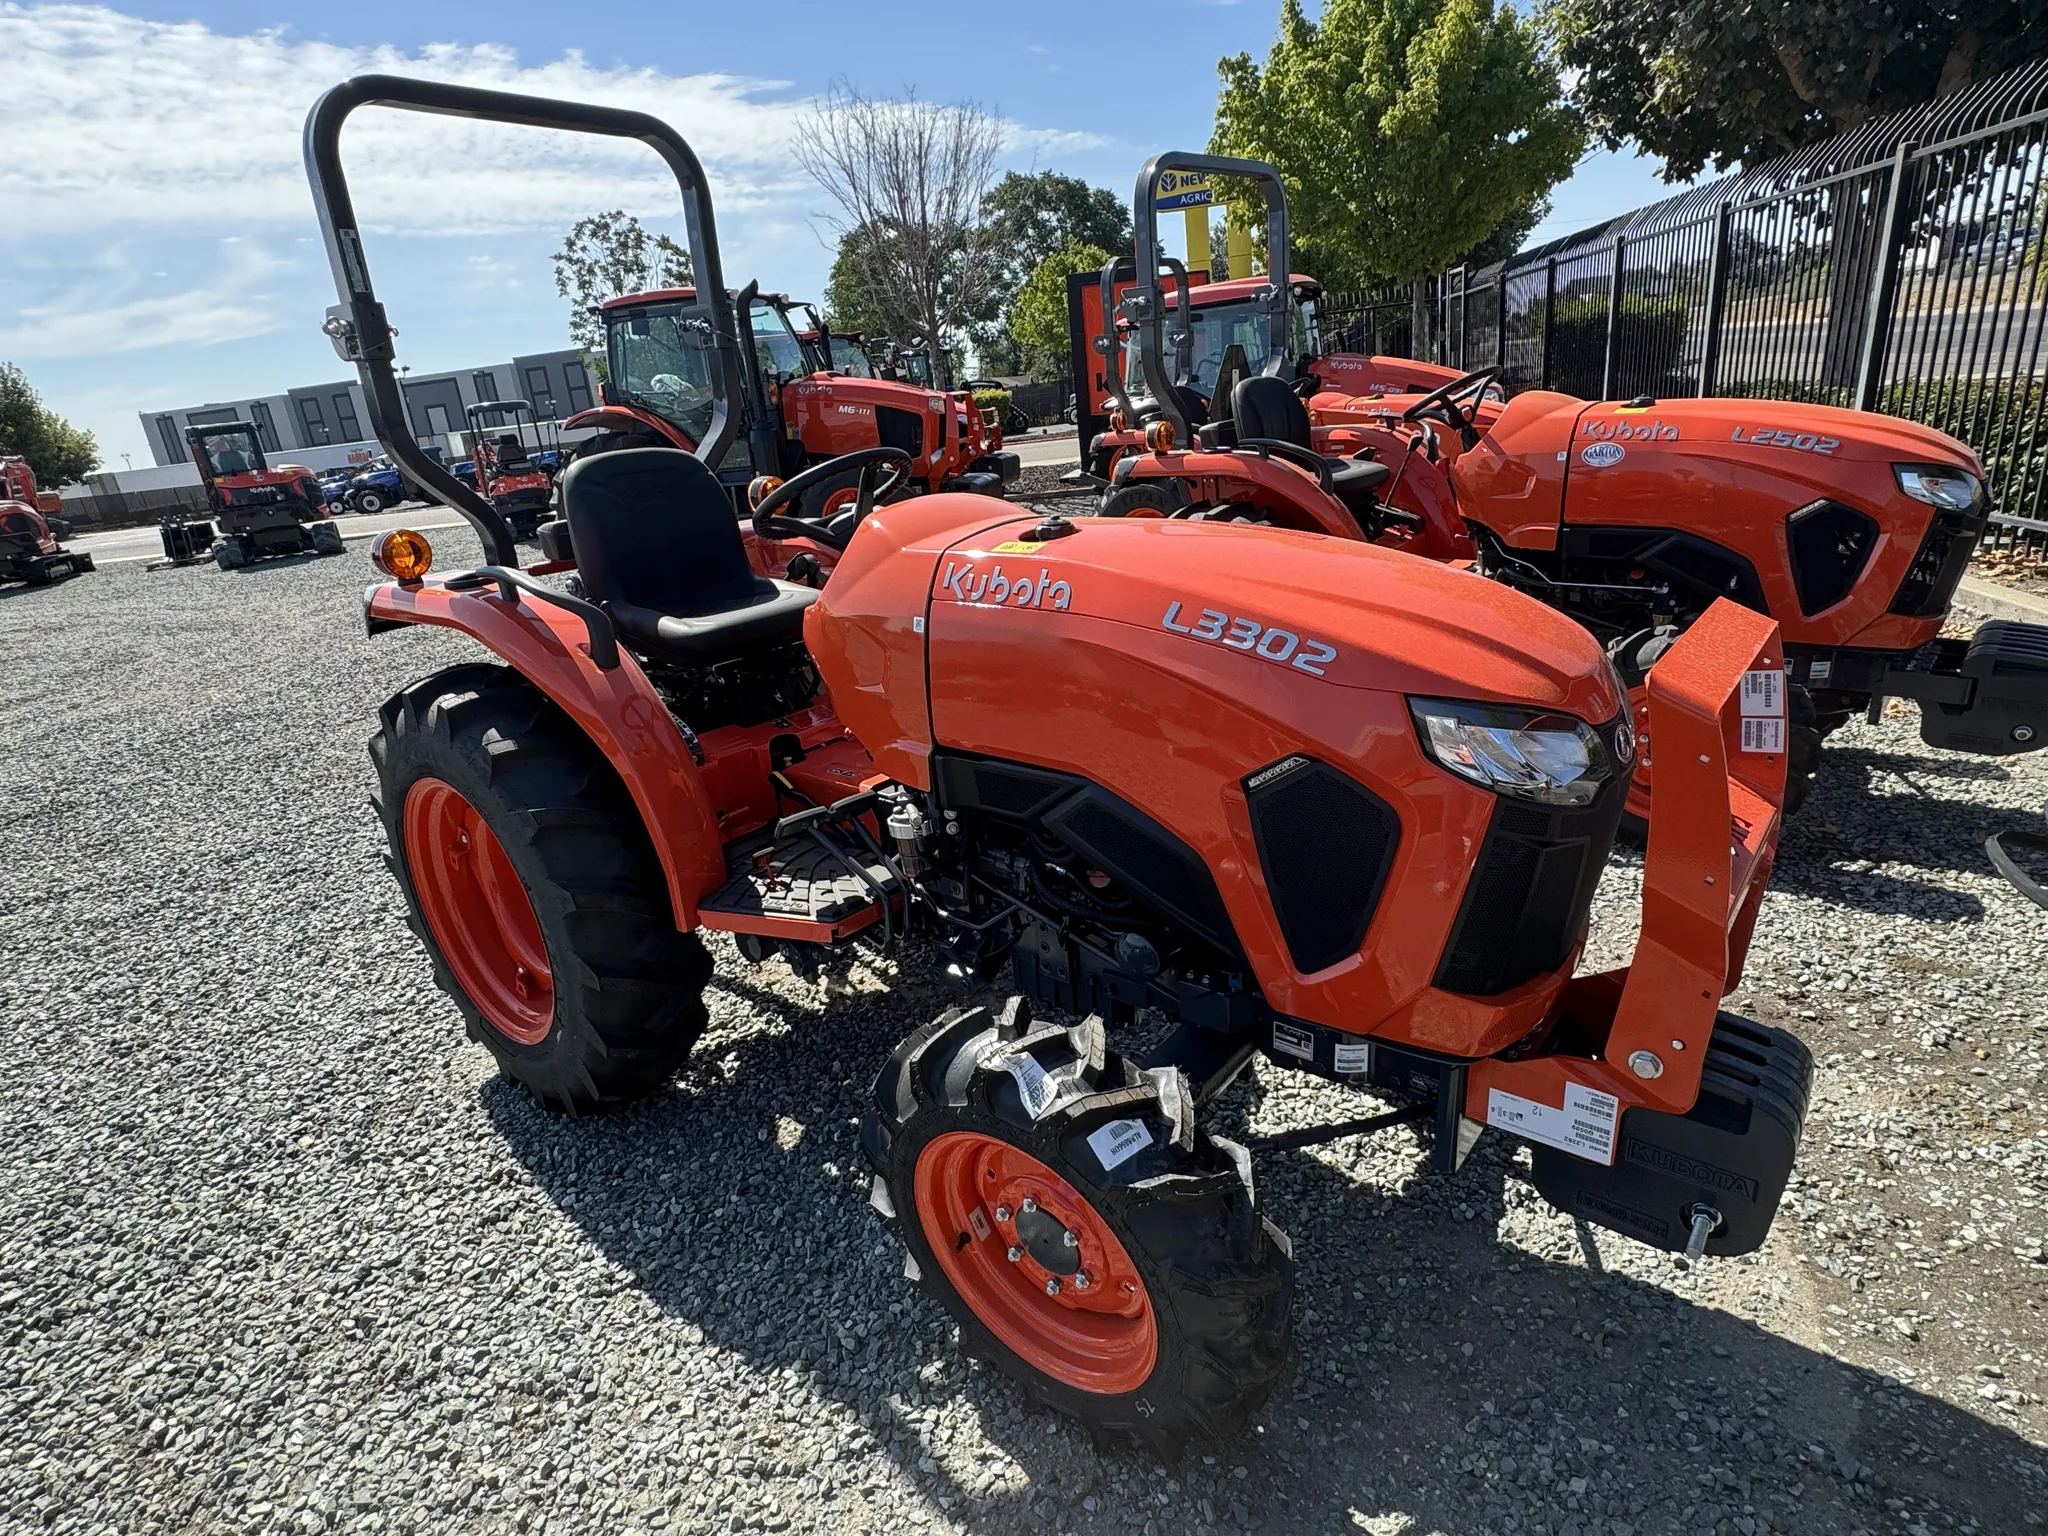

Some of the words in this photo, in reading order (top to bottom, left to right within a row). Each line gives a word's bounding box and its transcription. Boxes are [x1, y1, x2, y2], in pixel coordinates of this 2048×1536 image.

[1331, 360, 1363, 371] Kubota
[797, 385, 833, 395] Kubota
[838, 405, 871, 416] M6-111
[1582, 419, 1680, 441] Kubota
[1731, 426, 1841, 455] L2502
[1585, 444, 1622, 458] GARTON
[943, 561, 1072, 610] Kubota
[1162, 600, 1338, 677] L3302
[1532, 1105, 1543, 1117] 12
[1630, 1142, 1752, 1200] KUBOTA
